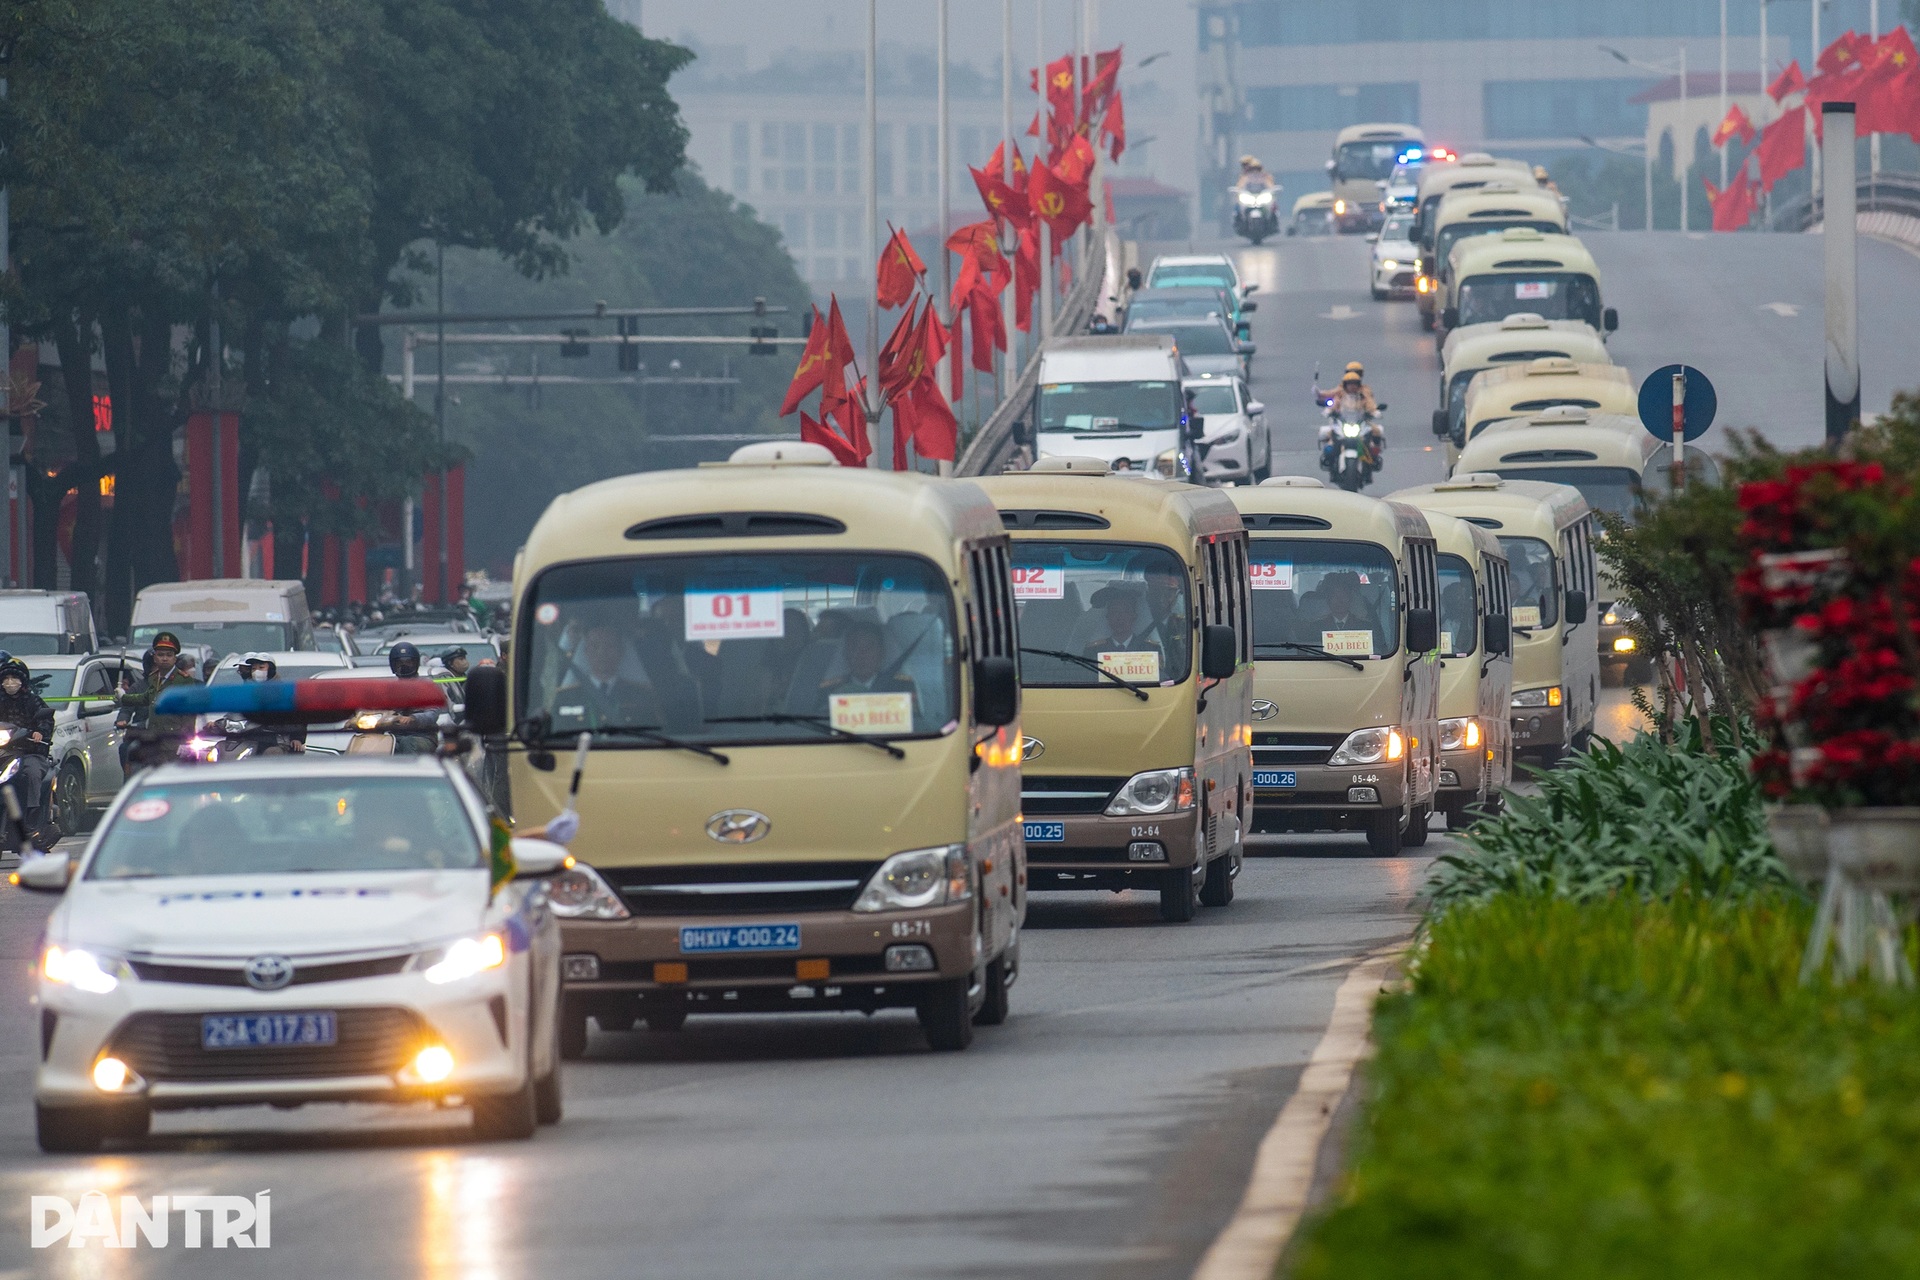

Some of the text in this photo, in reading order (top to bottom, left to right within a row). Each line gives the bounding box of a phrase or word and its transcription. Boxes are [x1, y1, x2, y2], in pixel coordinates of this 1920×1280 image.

[1011, 566, 1045, 584] 02
[1249, 562, 1276, 578] 03
[712, 594, 751, 618] 01
[1131, 825, 1160, 837] 02-64
